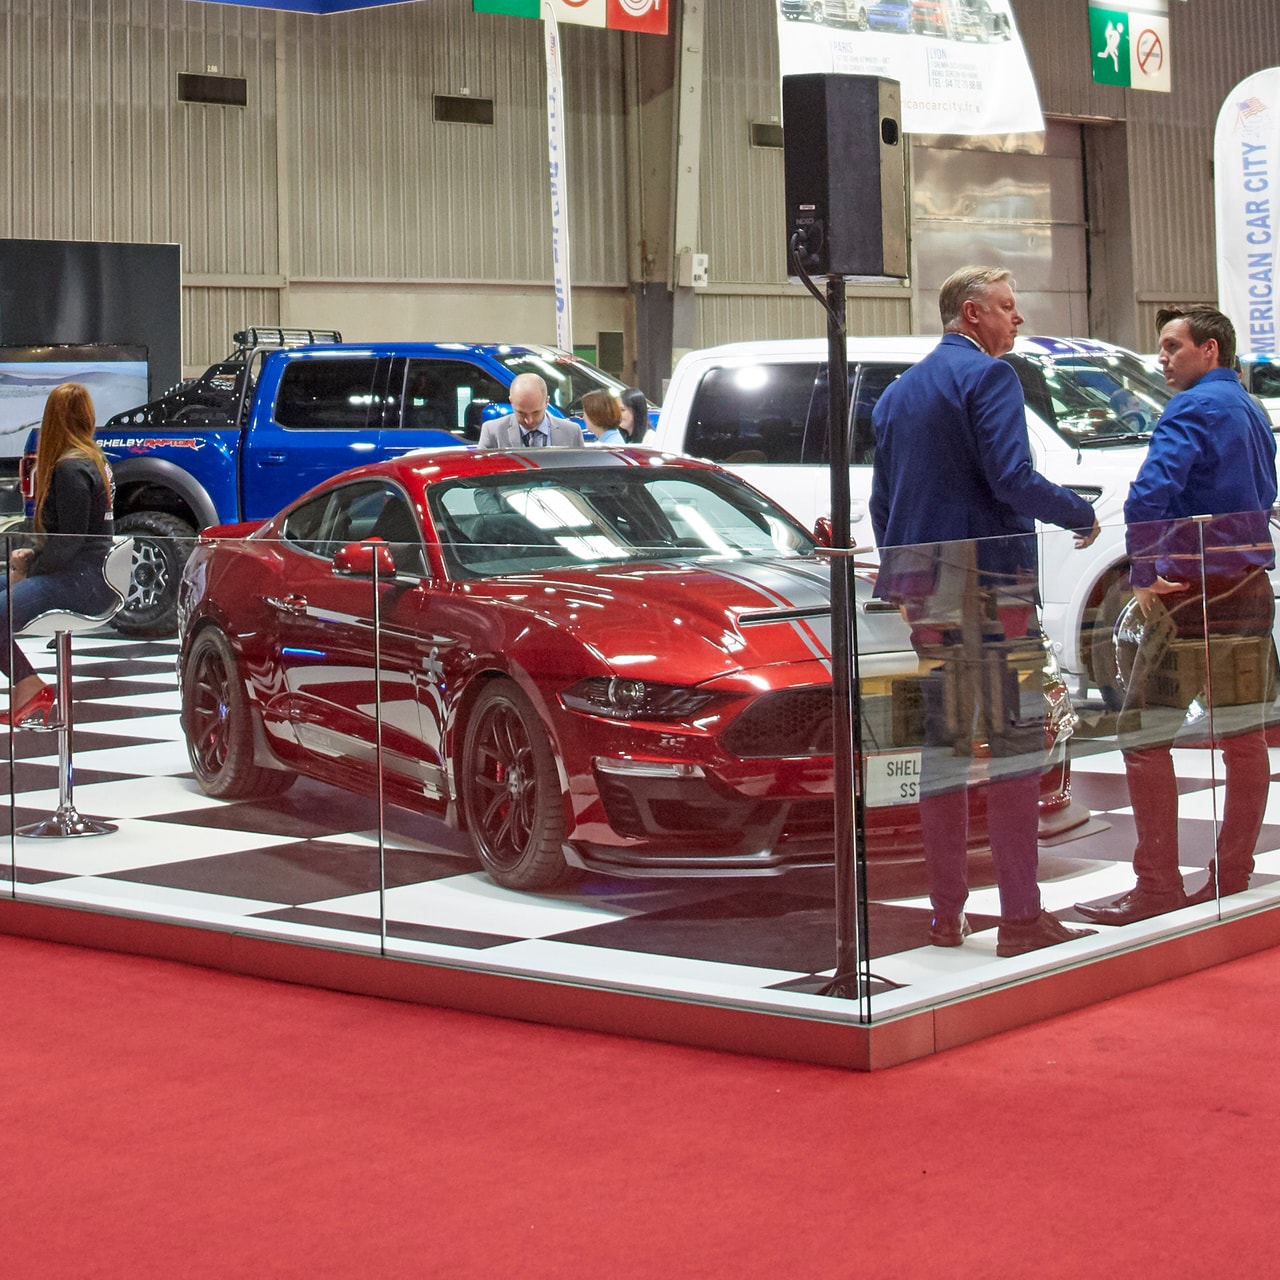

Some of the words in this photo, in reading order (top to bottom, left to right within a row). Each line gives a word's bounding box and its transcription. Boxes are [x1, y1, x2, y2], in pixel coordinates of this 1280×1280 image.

[1241, 141, 1267, 194] CITY
[1245, 198, 1271, 246] CAR
[1248, 252, 1276, 353] MERICAN
[96, 438, 144, 448] SHELBY
[886, 759, 920, 777] SHEL
[900, 782, 920, 798] SS
